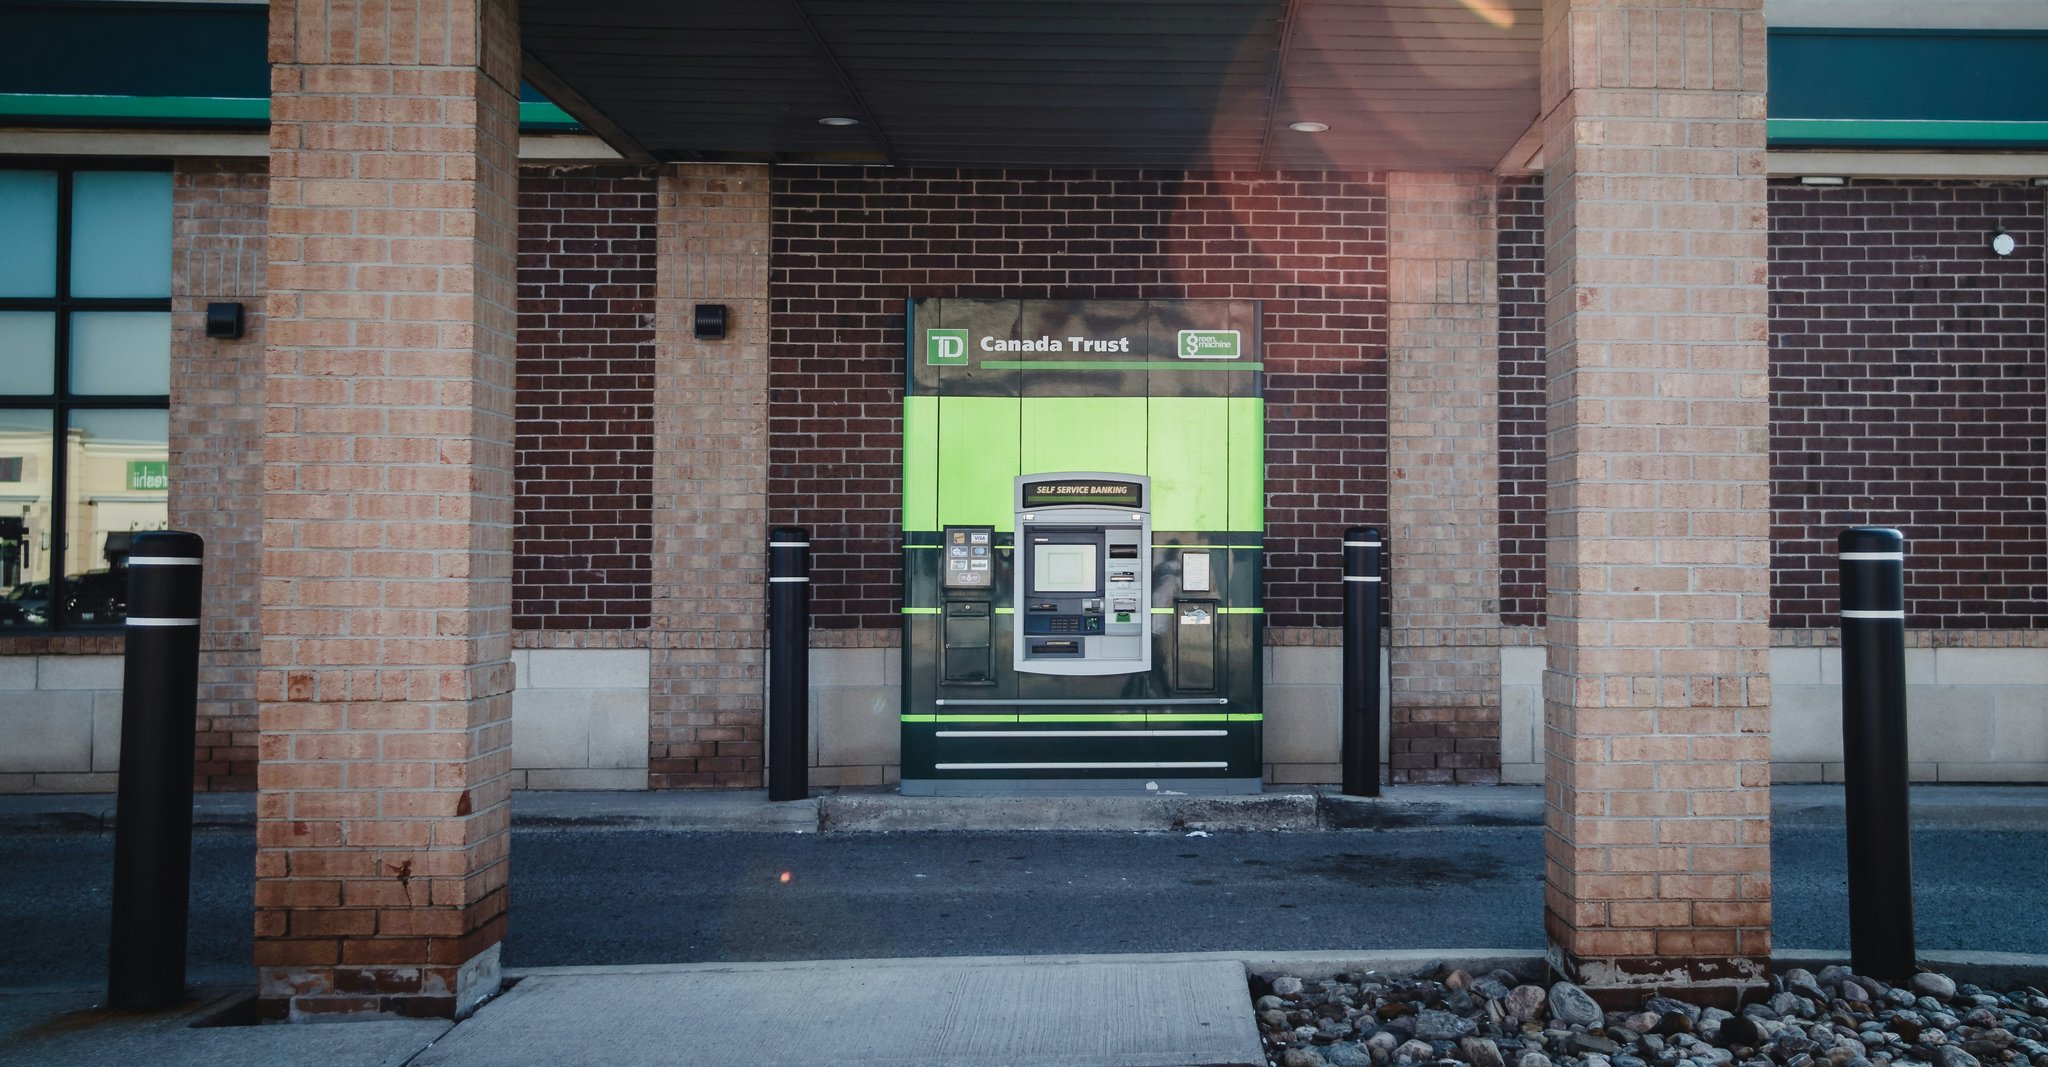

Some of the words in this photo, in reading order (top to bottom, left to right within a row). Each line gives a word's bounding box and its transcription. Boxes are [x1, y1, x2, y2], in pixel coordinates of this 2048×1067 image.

[931, 335, 964, 358] TD
[980, 335, 1063, 352] Canada
[1067, 335, 1129, 352] Trust
[1198, 340, 1232, 348] machine
[1036, 485, 1056, 494] SELF
[1056, 485, 1089, 494] SERVICE
[1090, 485, 1128, 494] BANKING
